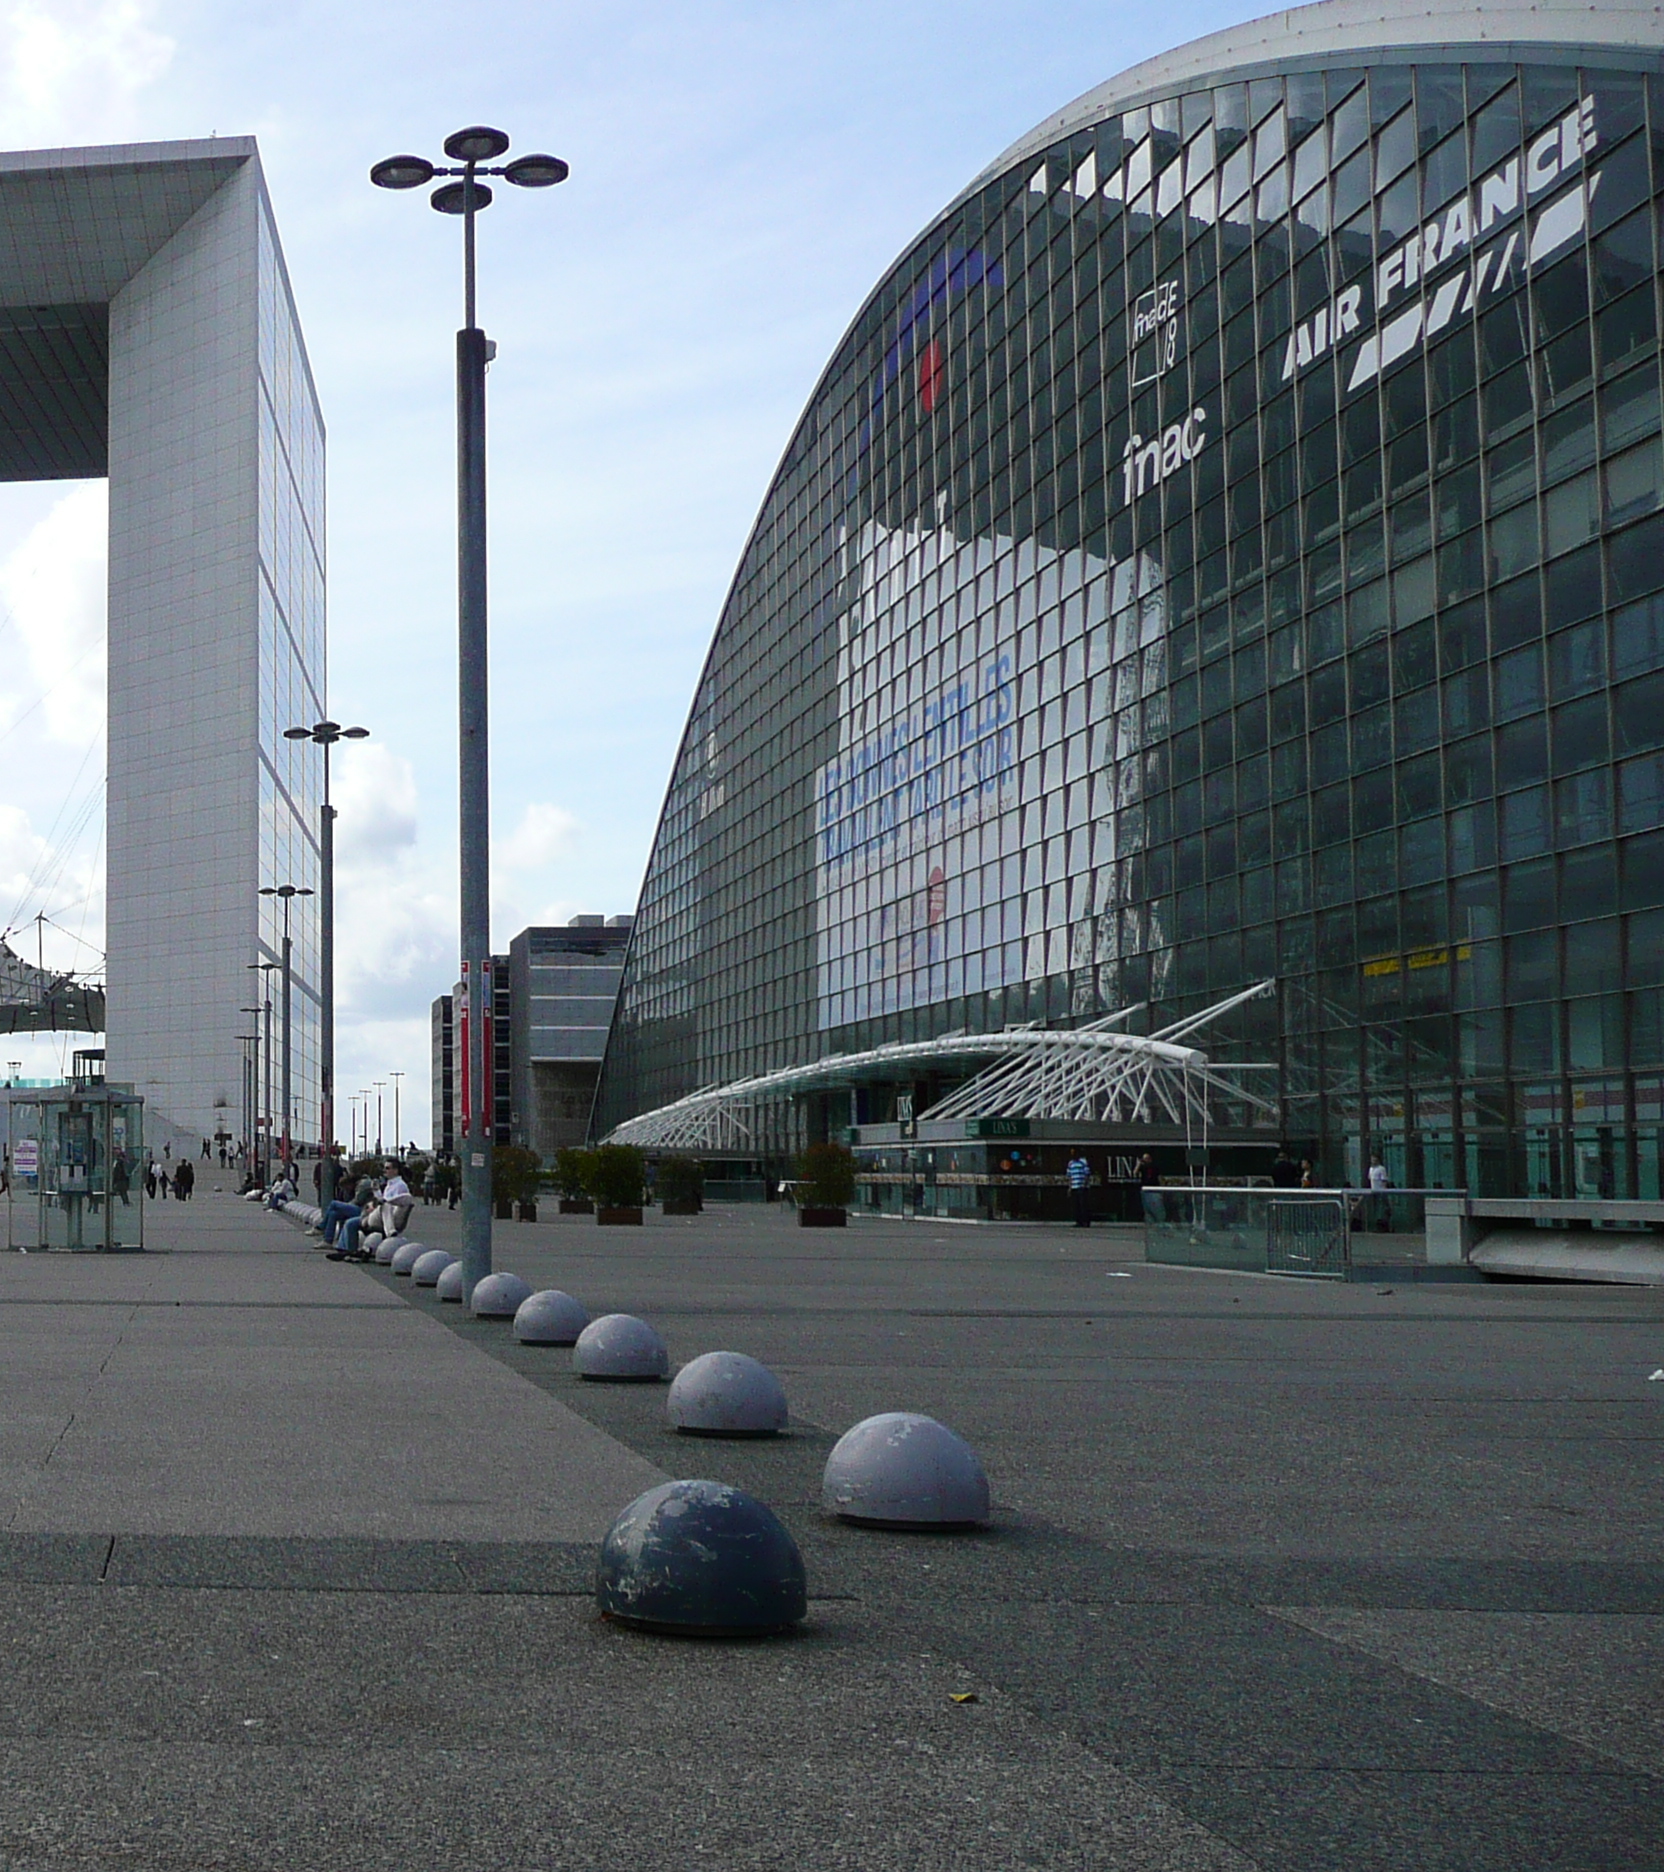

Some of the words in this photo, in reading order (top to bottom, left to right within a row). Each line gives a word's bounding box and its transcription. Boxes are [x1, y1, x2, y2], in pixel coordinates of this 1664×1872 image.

[1282, 284, 1361, 382] AIR
[1378, 93, 1599, 311] FRANCE
[1123, 407, 1206, 506] fnac
